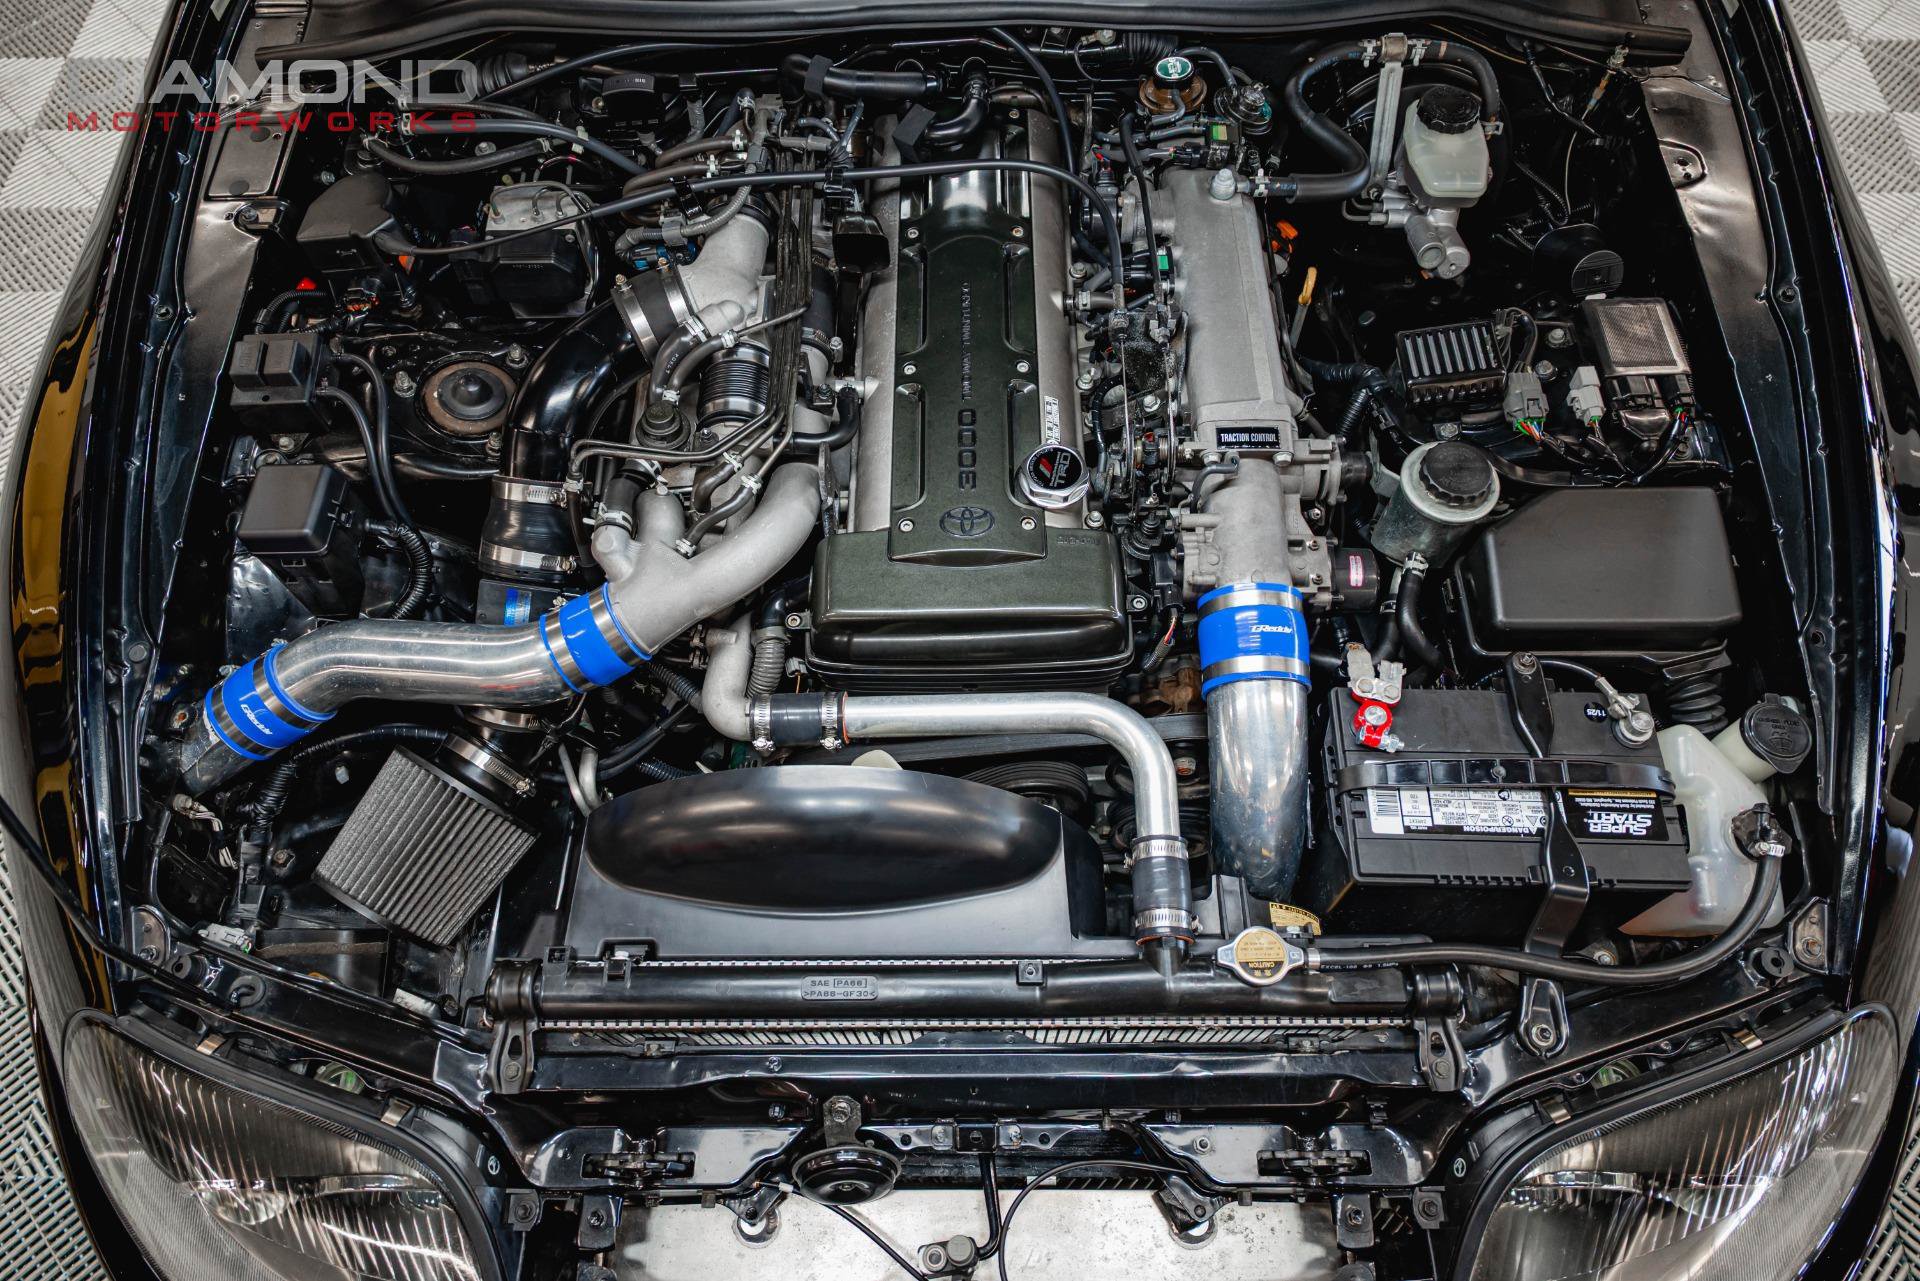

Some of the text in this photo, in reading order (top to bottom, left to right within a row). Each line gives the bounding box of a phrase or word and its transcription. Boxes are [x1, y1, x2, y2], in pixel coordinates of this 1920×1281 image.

[1220, 433, 1277, 442] TRACTION CONTROL
[958, 408, 977, 491] 3000
[1053, 452, 1071, 487] TRD
[1587, 812, 1652, 827] START
[1589, 822, 1647, 835] SUPER
[1248, 961, 1275, 969] CAUTION
